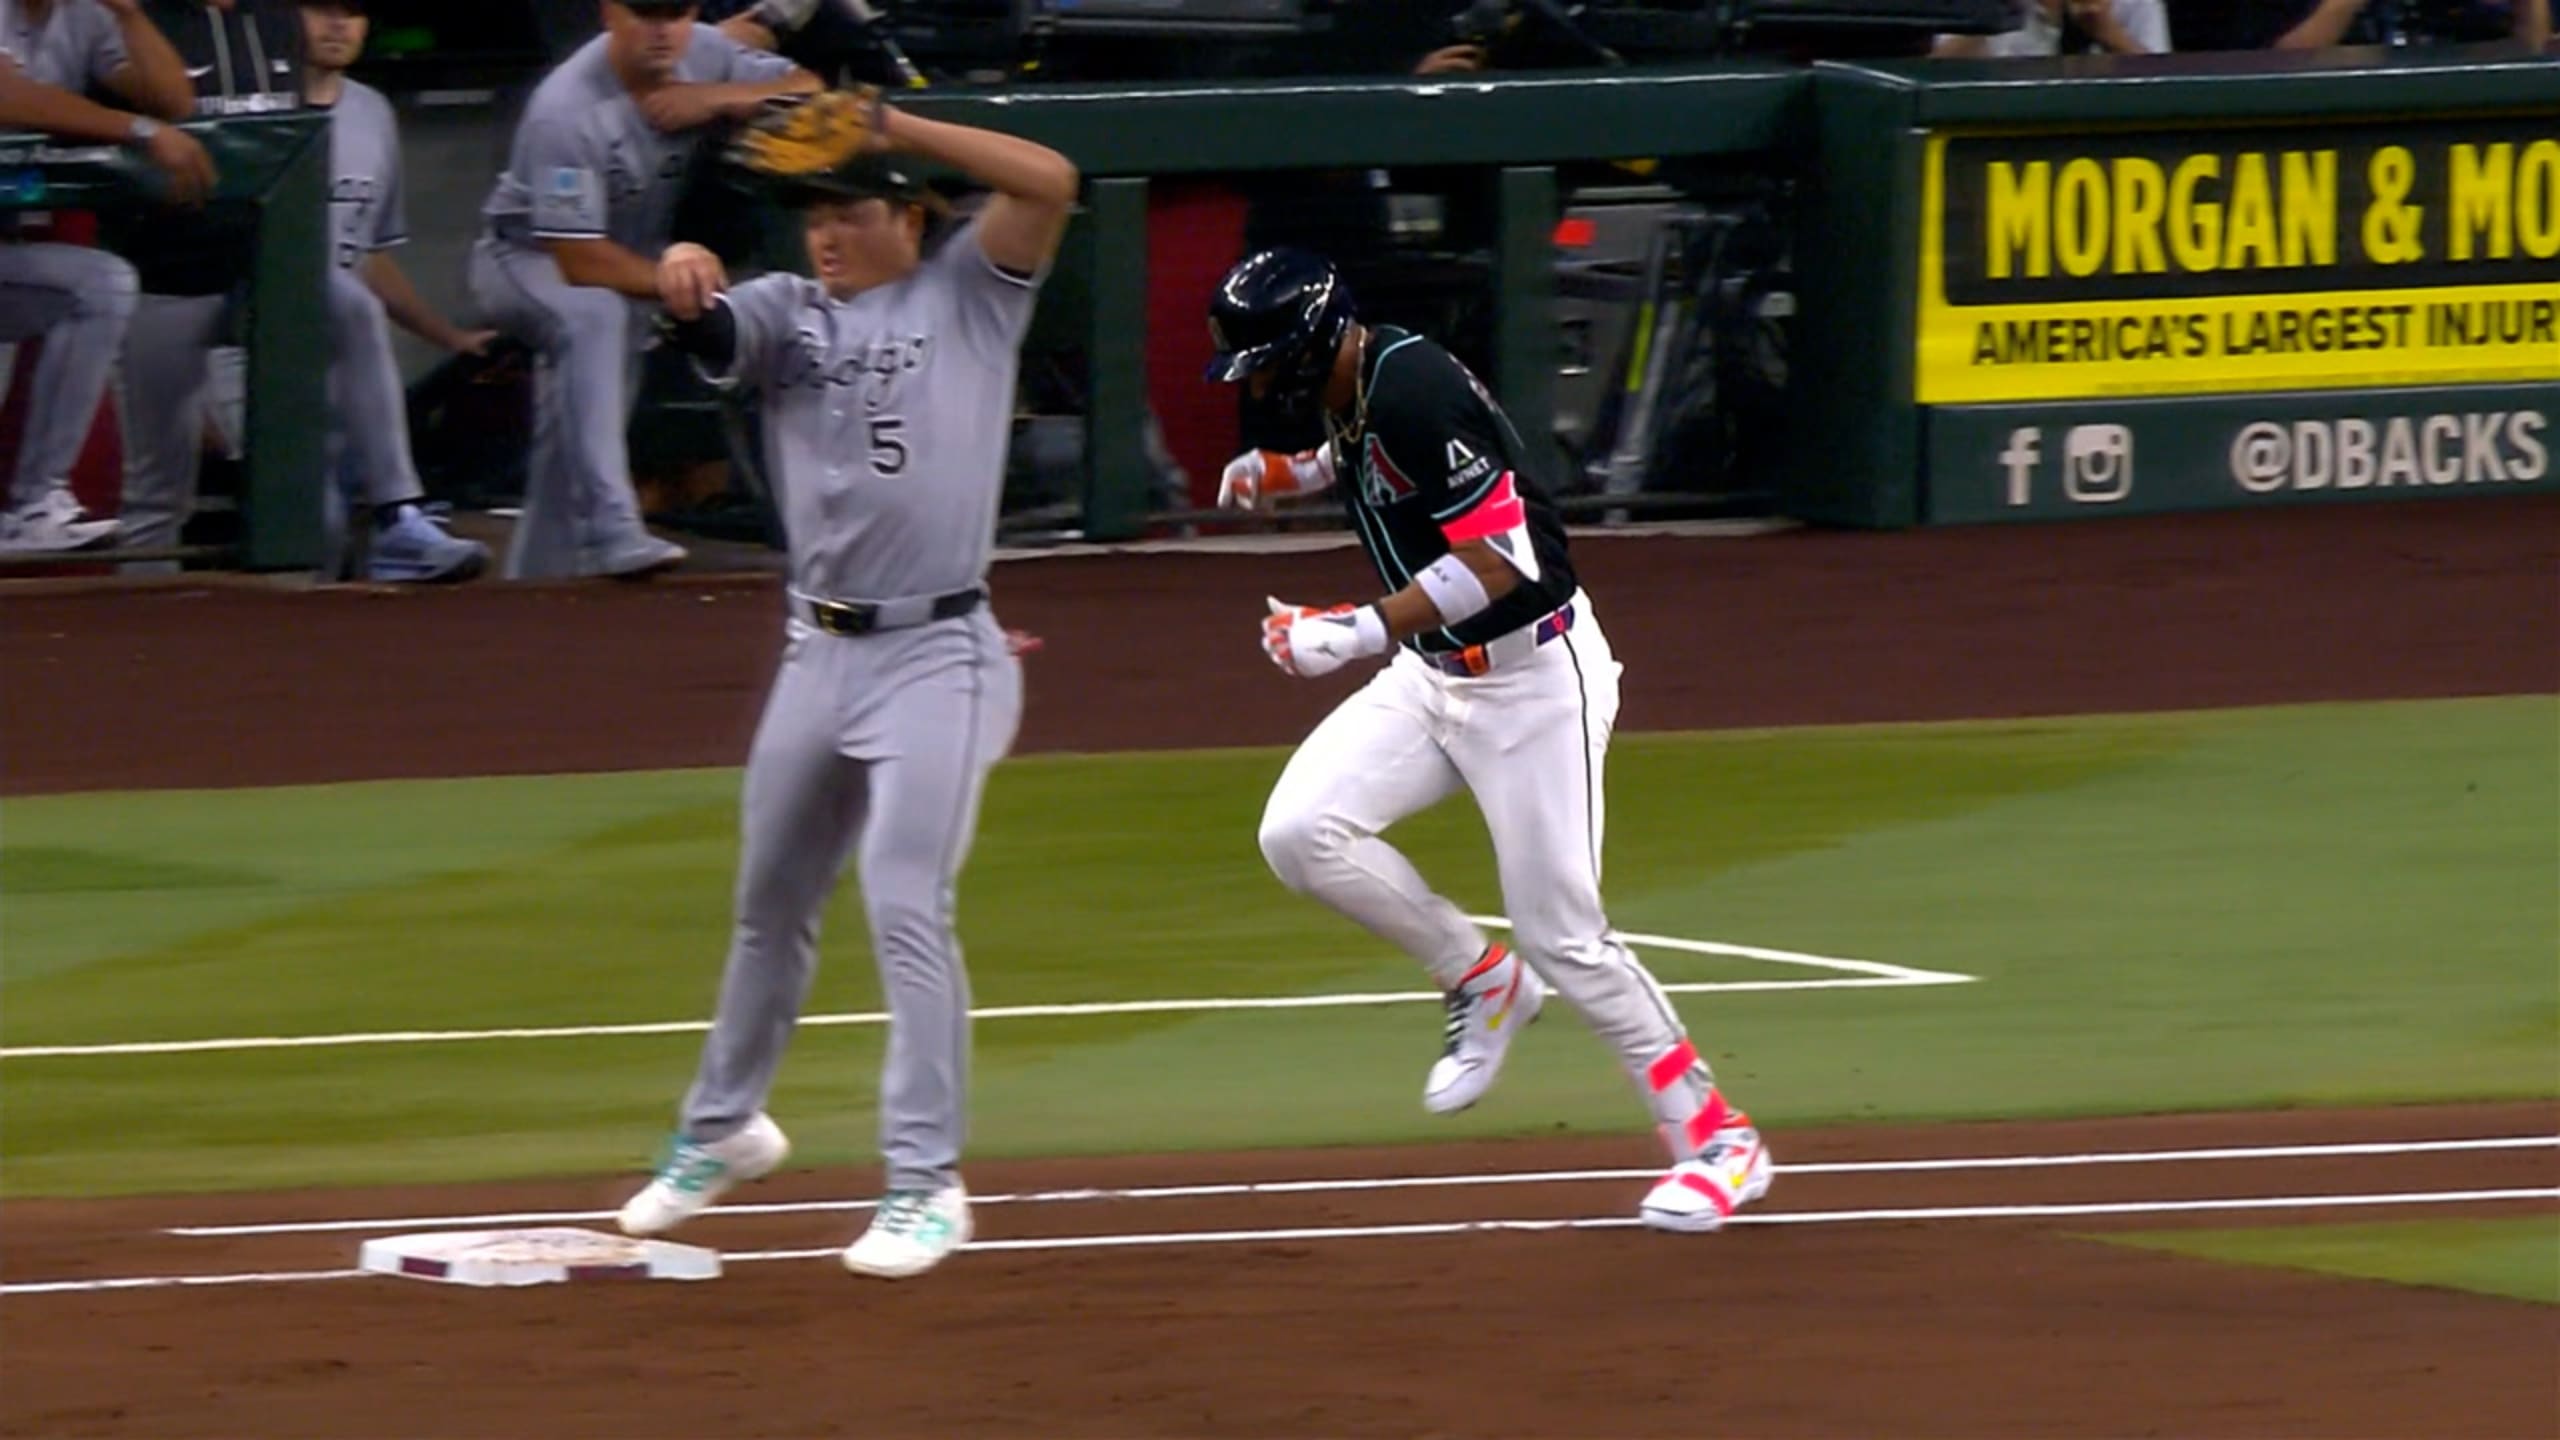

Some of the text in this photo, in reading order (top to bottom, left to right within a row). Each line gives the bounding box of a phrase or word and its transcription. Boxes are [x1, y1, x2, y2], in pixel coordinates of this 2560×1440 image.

[1985, 148, 2339, 279] MORGAN
[2363, 145, 2424, 264] &
[1972, 299, 2558, 366] AMERICA'S LARGEST INJUR
[866, 416, 908, 478] 5
[2231, 409, 2548, 493] @DBACKS
